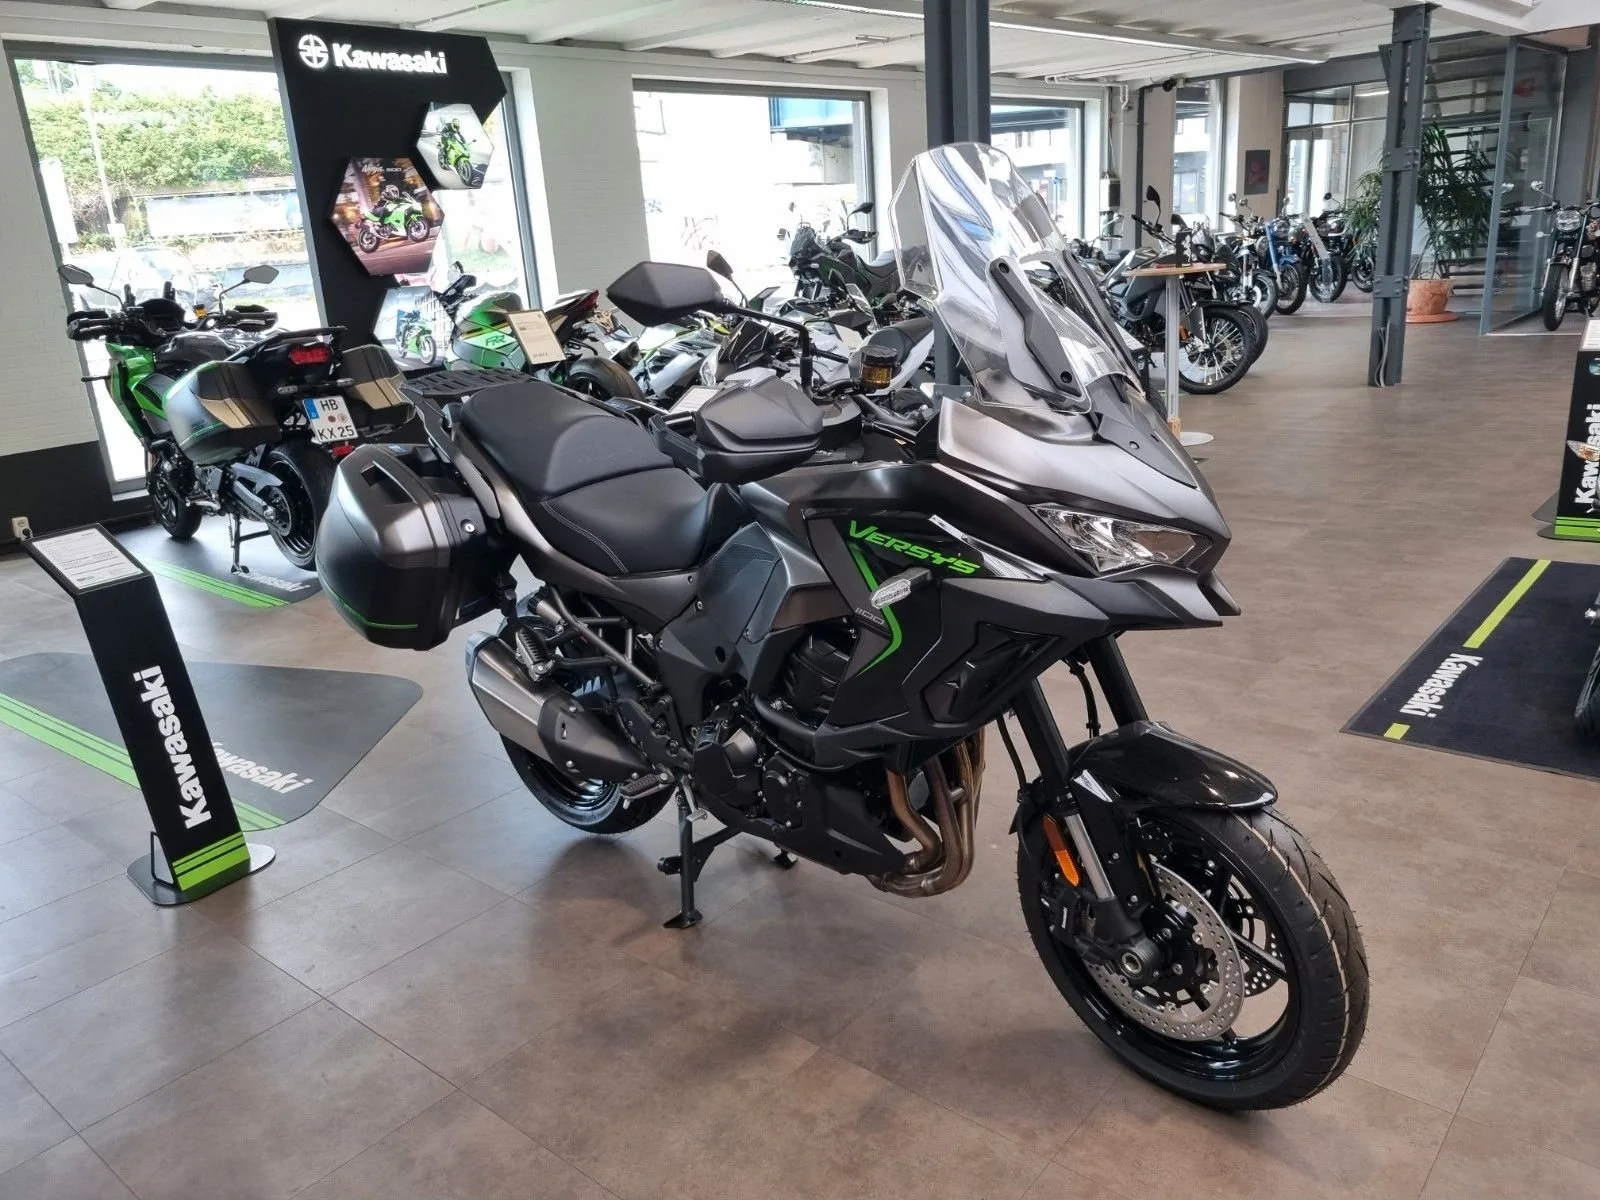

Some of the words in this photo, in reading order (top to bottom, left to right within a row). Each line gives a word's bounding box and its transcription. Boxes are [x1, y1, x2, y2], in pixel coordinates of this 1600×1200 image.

[332, 43, 447, 74] Kawasaki
[320, 399, 339, 411] HB
[318, 427, 337, 441] KX
[337, 425, 355, 438] 25
[1574, 403, 1600, 504] Kawsaki
[849, 520, 981, 574] VERSYS
[855, 607, 885, 626] 1100
[1399, 653, 1484, 718] Kawasaki
[133, 665, 212, 829] Kawasaki
